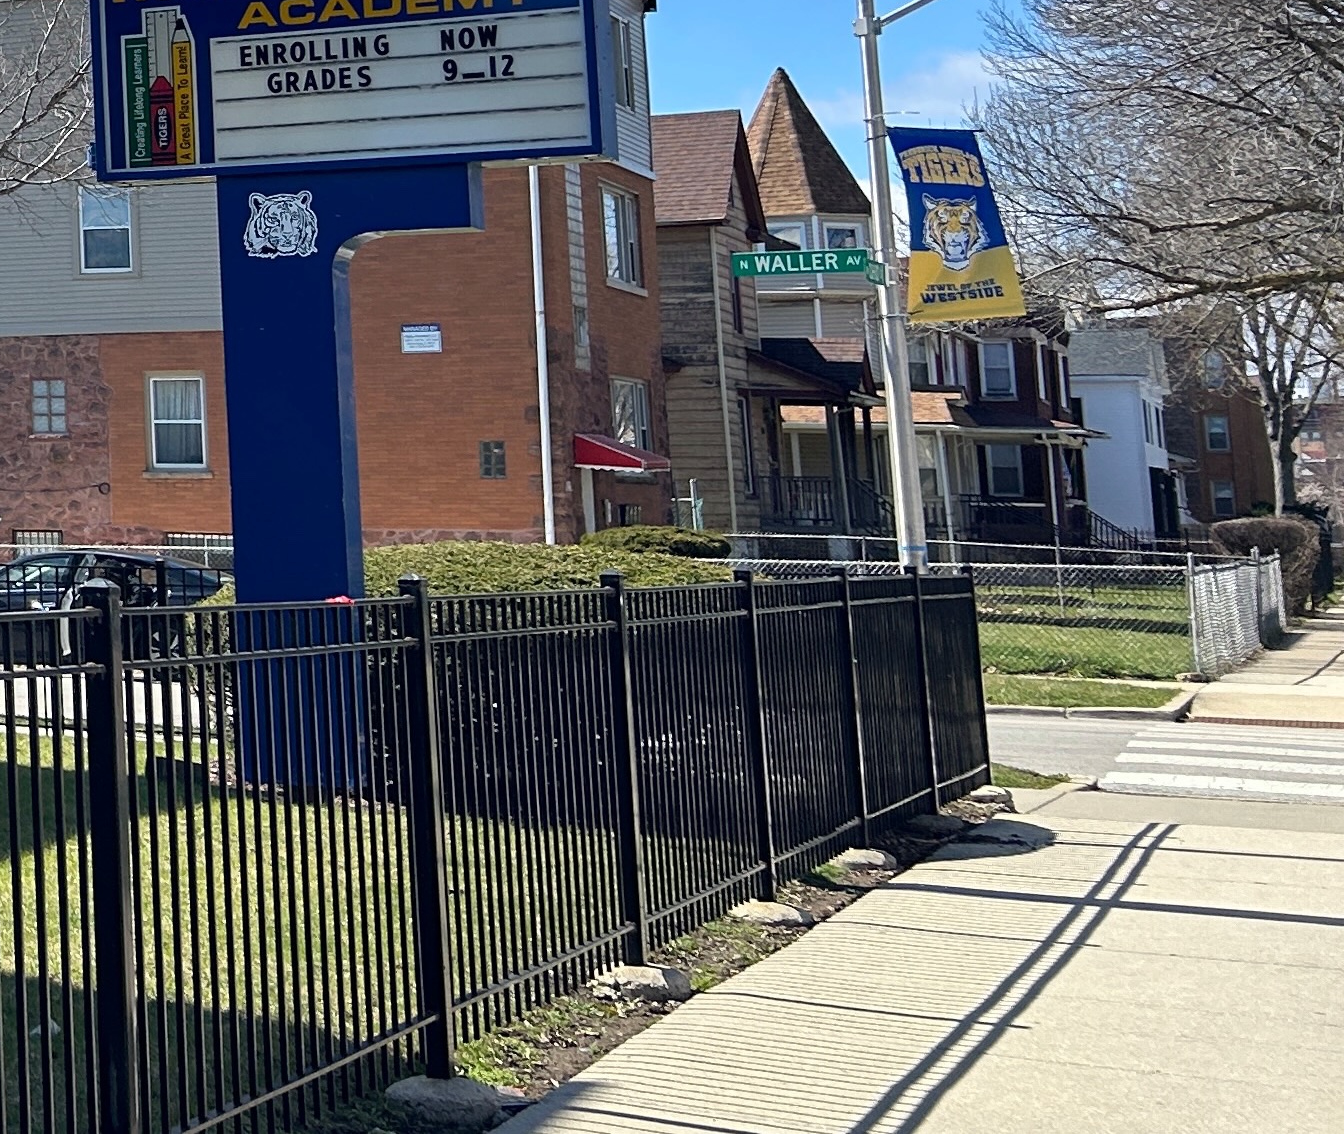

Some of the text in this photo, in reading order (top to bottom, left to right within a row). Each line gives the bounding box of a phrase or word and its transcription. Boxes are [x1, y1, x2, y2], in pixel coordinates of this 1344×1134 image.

[239, 24, 498, 67] ENROLLING NOW
[178, 79, 188, 90] To
[267, 66, 372, 93] GRADES
[133, 48, 147, 157] Creating Lifelong Learners
[179, 94, 190, 119] Place
[158, 107, 168, 147] TIGERS
[180, 123, 191, 149] Great
[180, 152, 191, 160] A
[901, 152, 985, 187] TIGERS
[740, 253, 862, 273] N WALLER AV
[920, 286, 1004, 304] WESTSIDE
[925, 278, 996, 292] JEWEL OF THE
